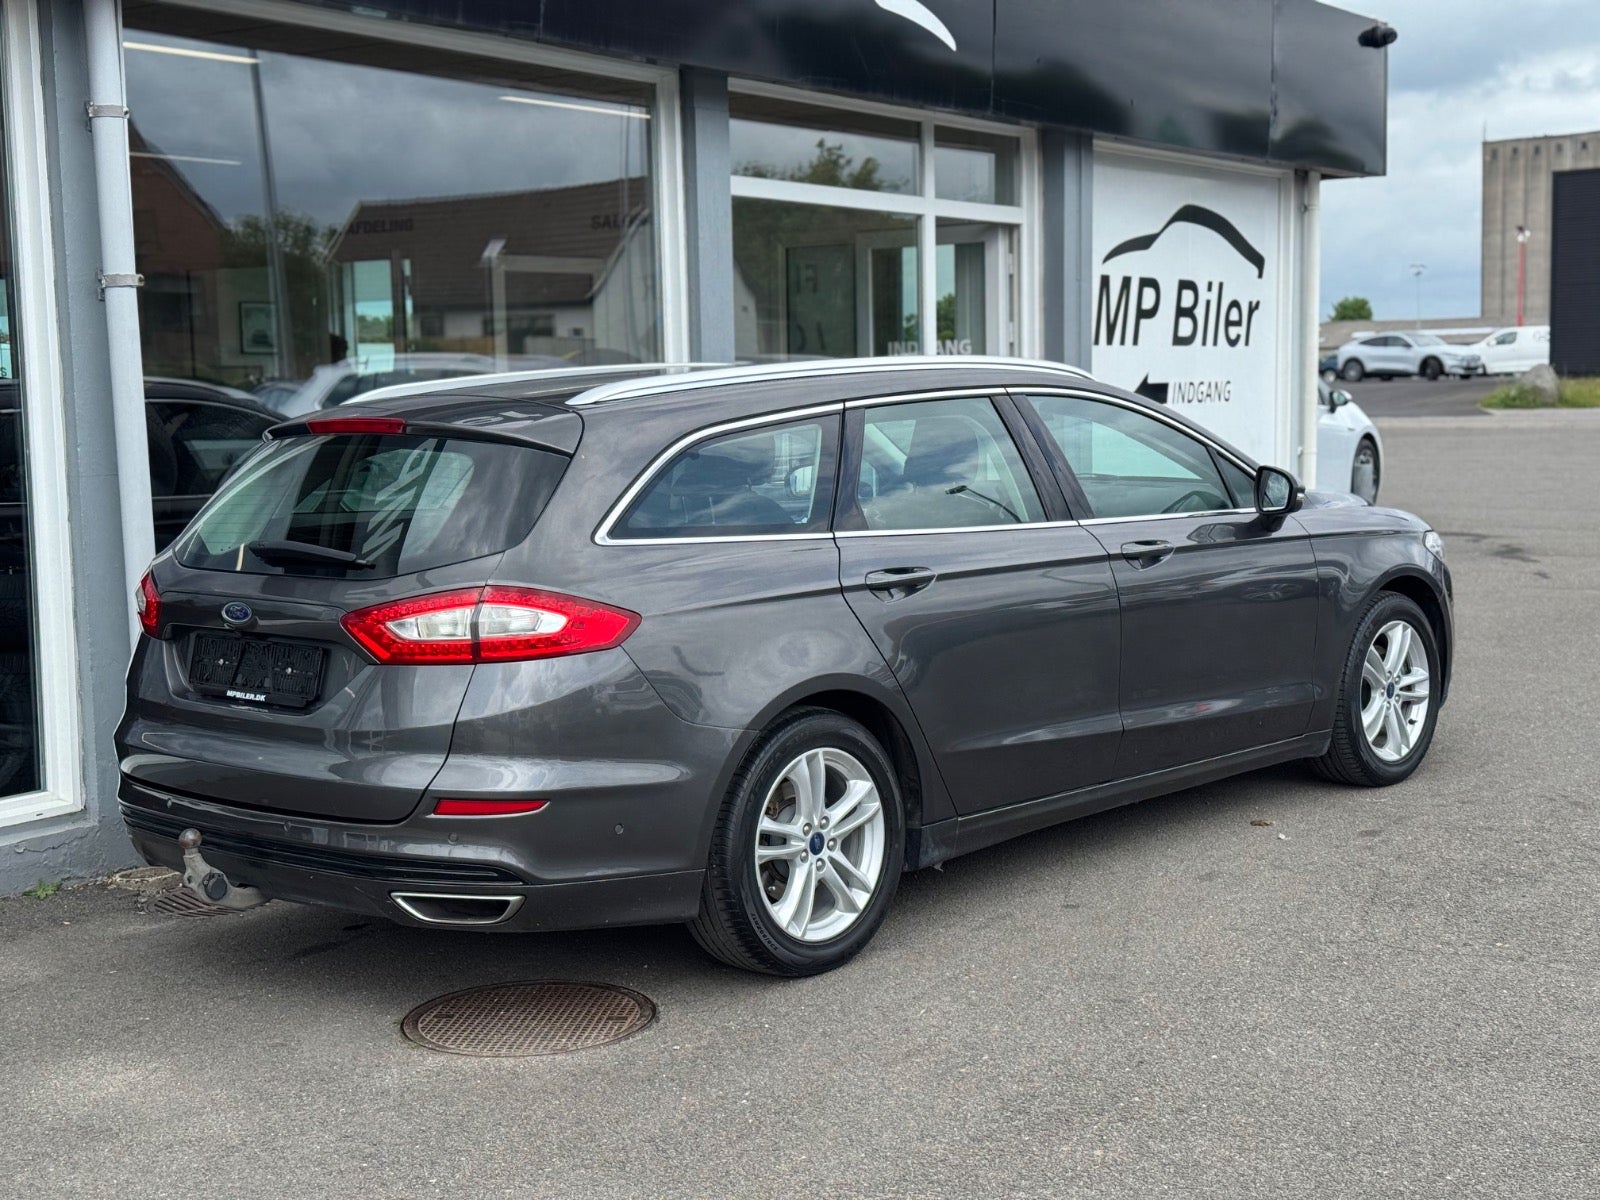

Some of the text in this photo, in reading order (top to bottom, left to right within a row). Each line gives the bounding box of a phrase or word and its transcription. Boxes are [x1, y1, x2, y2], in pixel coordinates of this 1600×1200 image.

[1093, 274, 1260, 347] MP Biler
[887, 339, 972, 356] INDANG
[1172, 380, 1231, 404] INDGANG
[226, 689, 266, 702] MPBILER.DK
